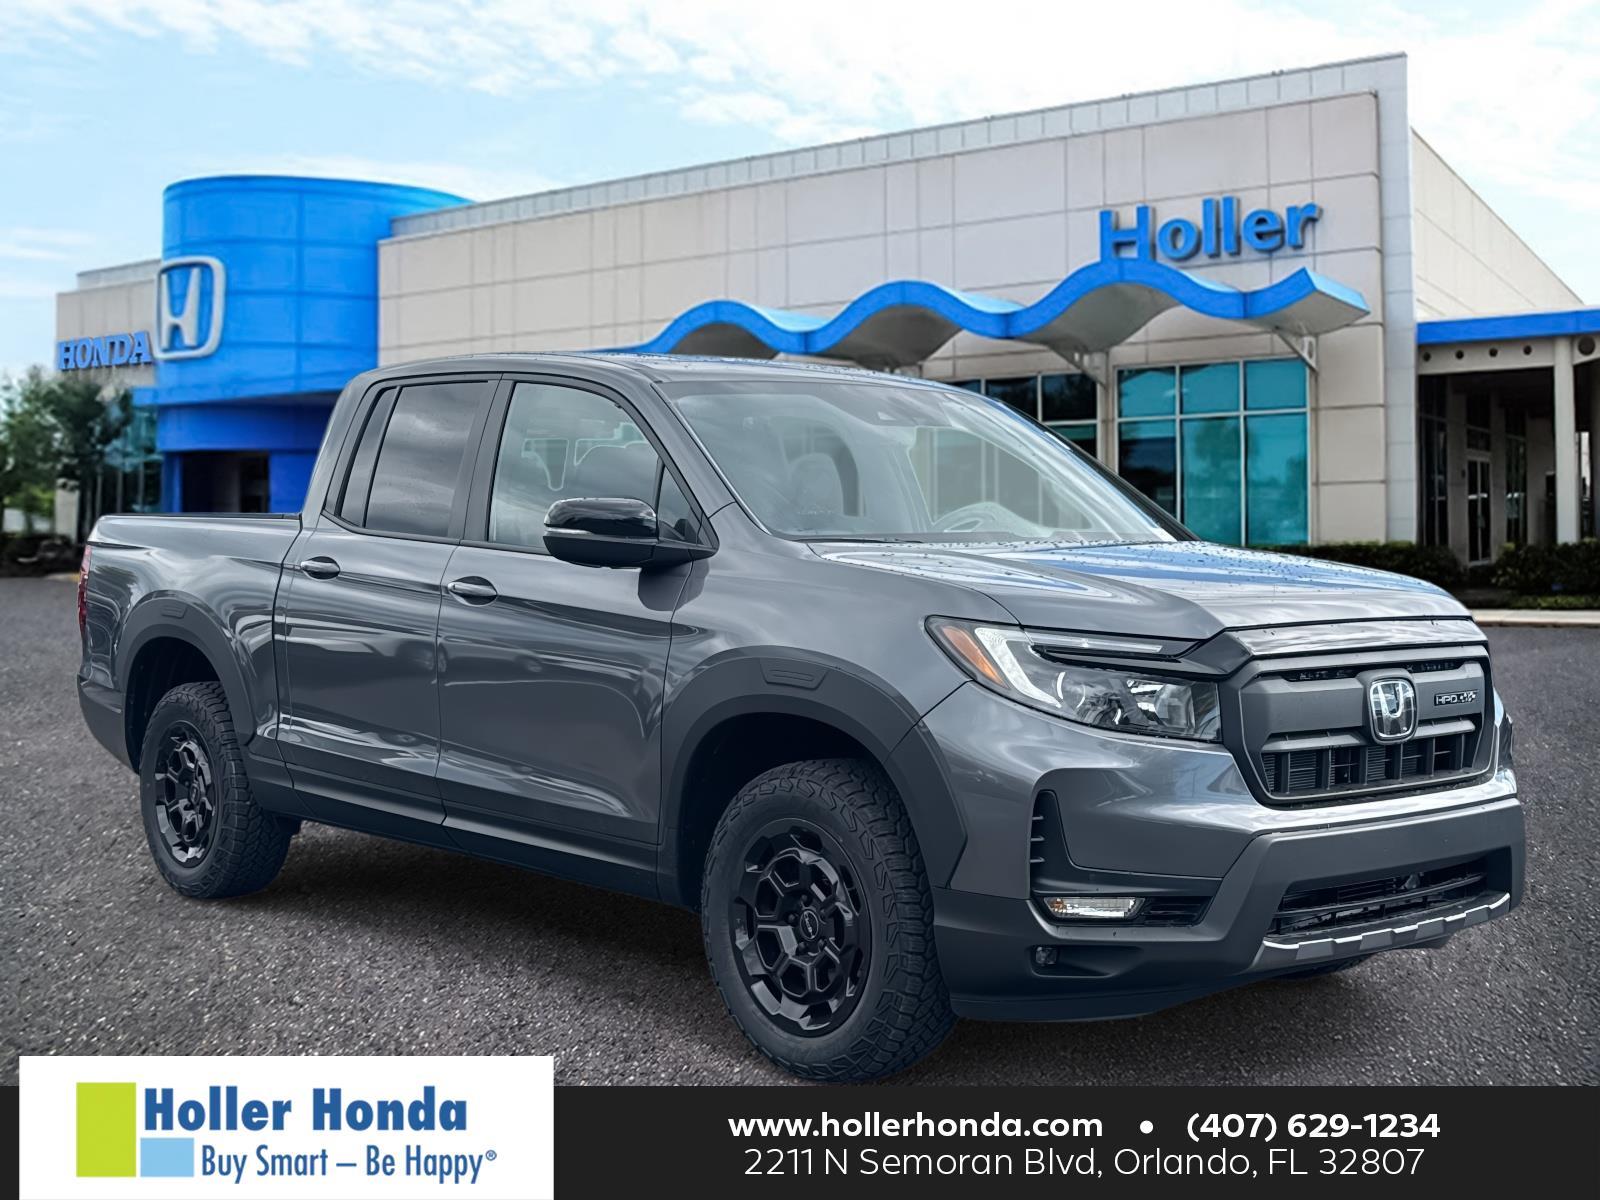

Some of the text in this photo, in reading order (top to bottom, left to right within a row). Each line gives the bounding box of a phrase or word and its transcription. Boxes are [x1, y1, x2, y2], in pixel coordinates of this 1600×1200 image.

[1100, 195, 1322, 261] Holler
[57, 331, 152, 370] HONDA
[1435, 694, 1458, 705] HPD
